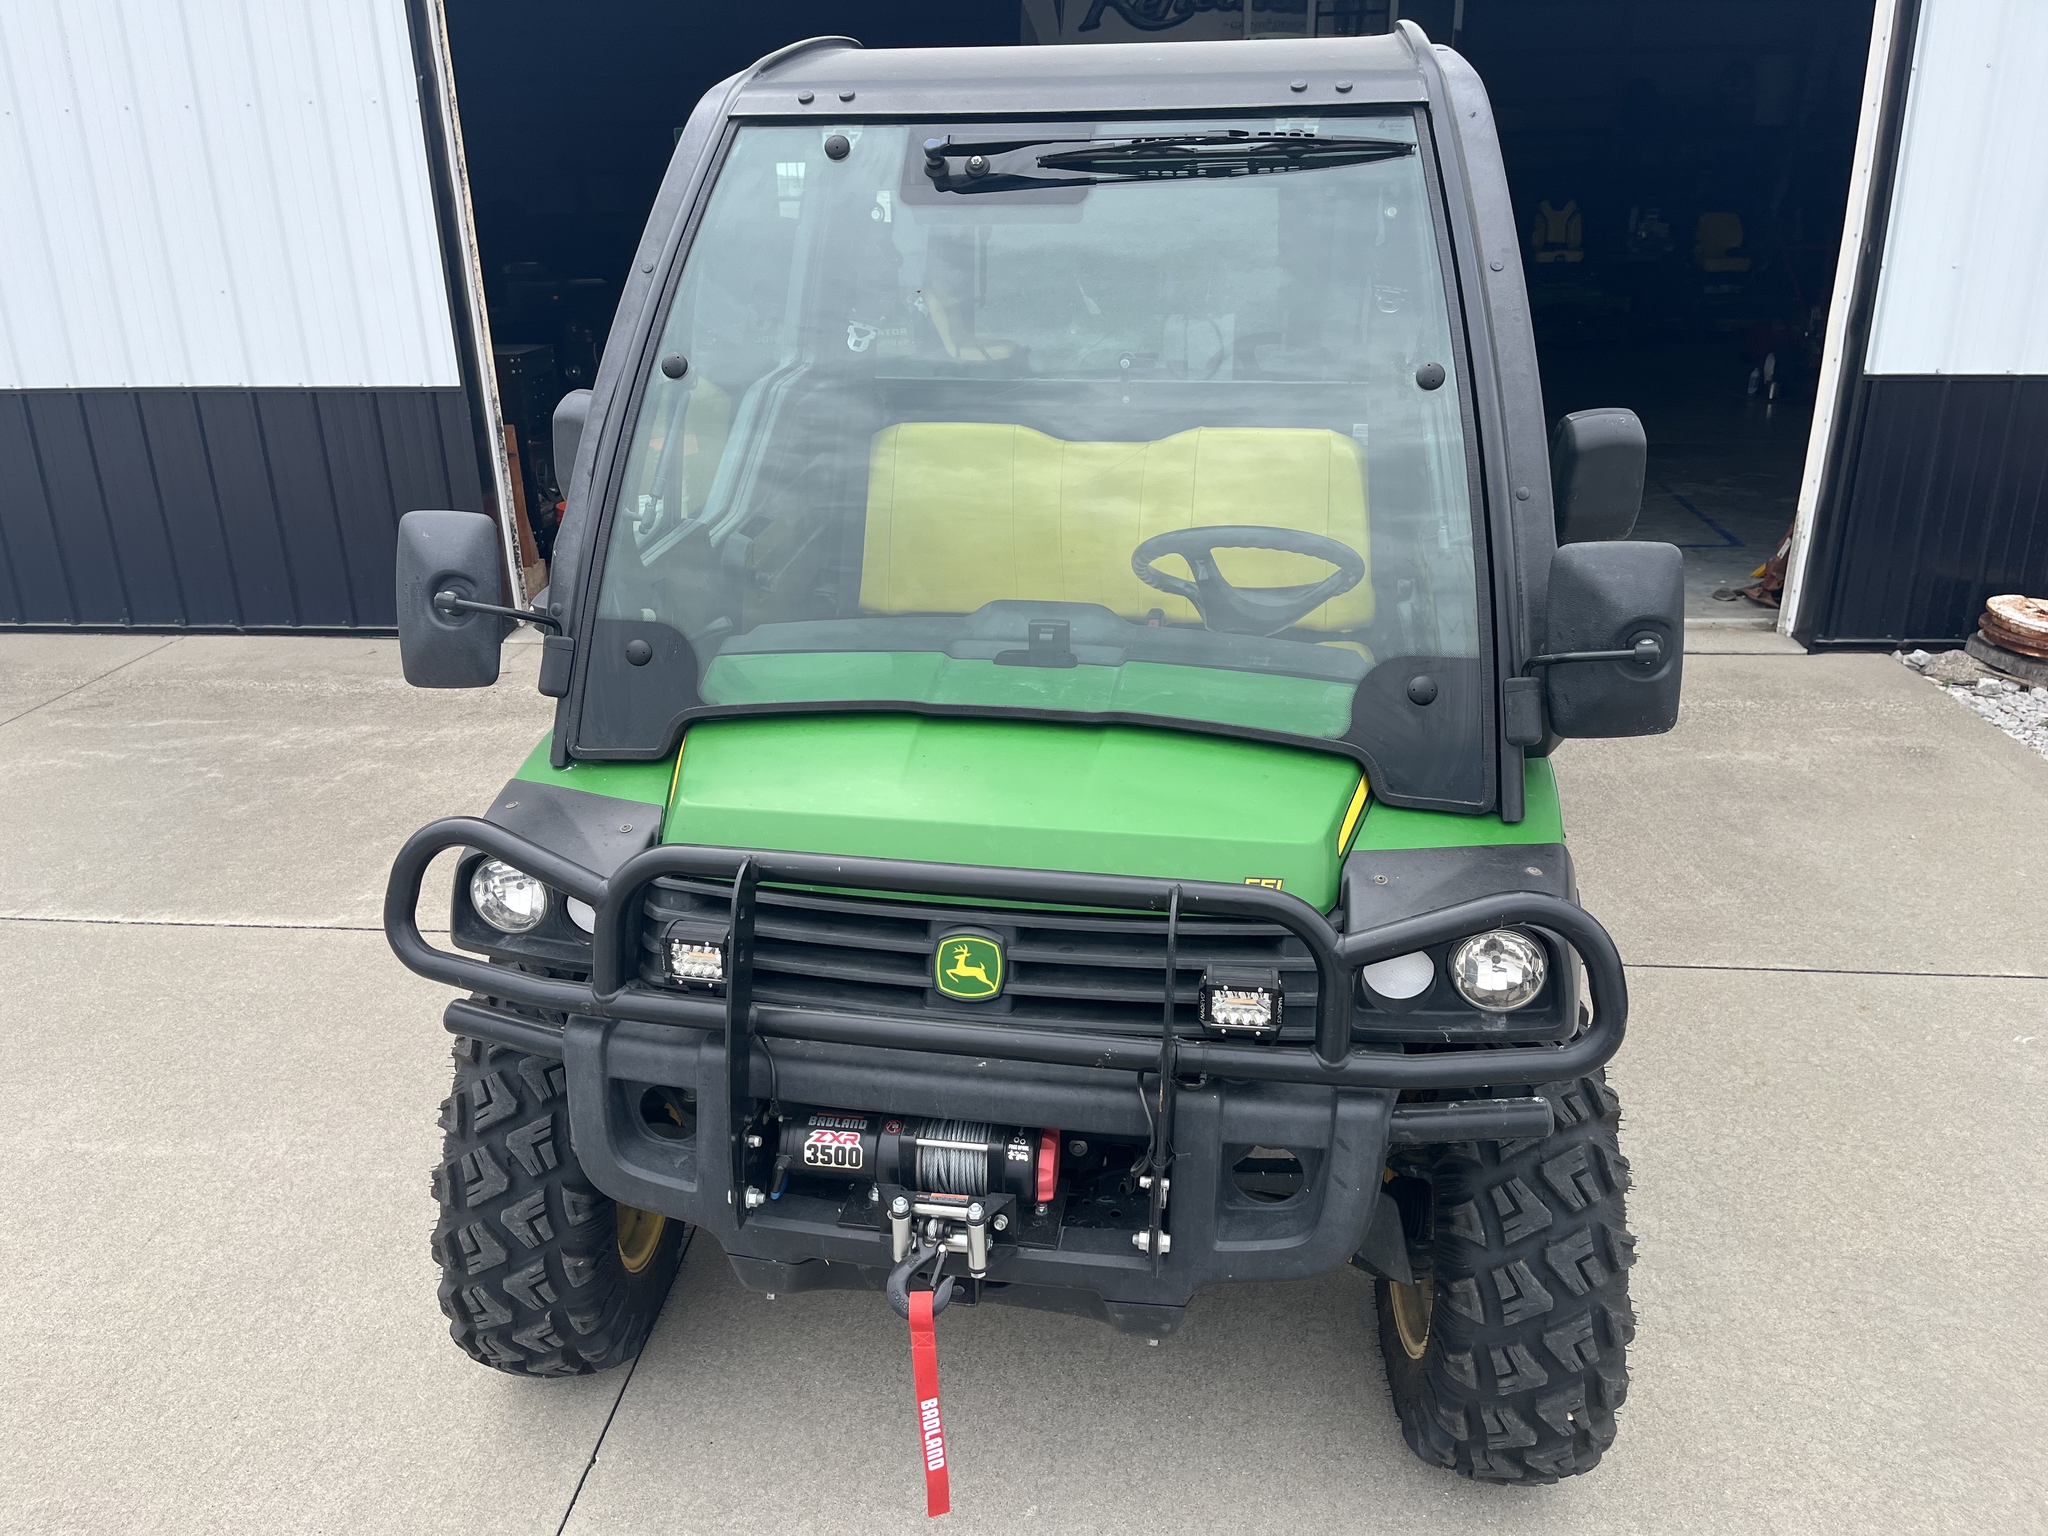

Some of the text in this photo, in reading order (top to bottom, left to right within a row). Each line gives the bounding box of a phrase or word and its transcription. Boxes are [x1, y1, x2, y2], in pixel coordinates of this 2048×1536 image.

[808, 1115, 868, 1130] BADLAND
[808, 1131, 861, 1146] ZXR
[806, 1144, 861, 1167] 3500
[891, 1289, 909, 1311] FORG
[920, 1397, 945, 1472] BADLAND
